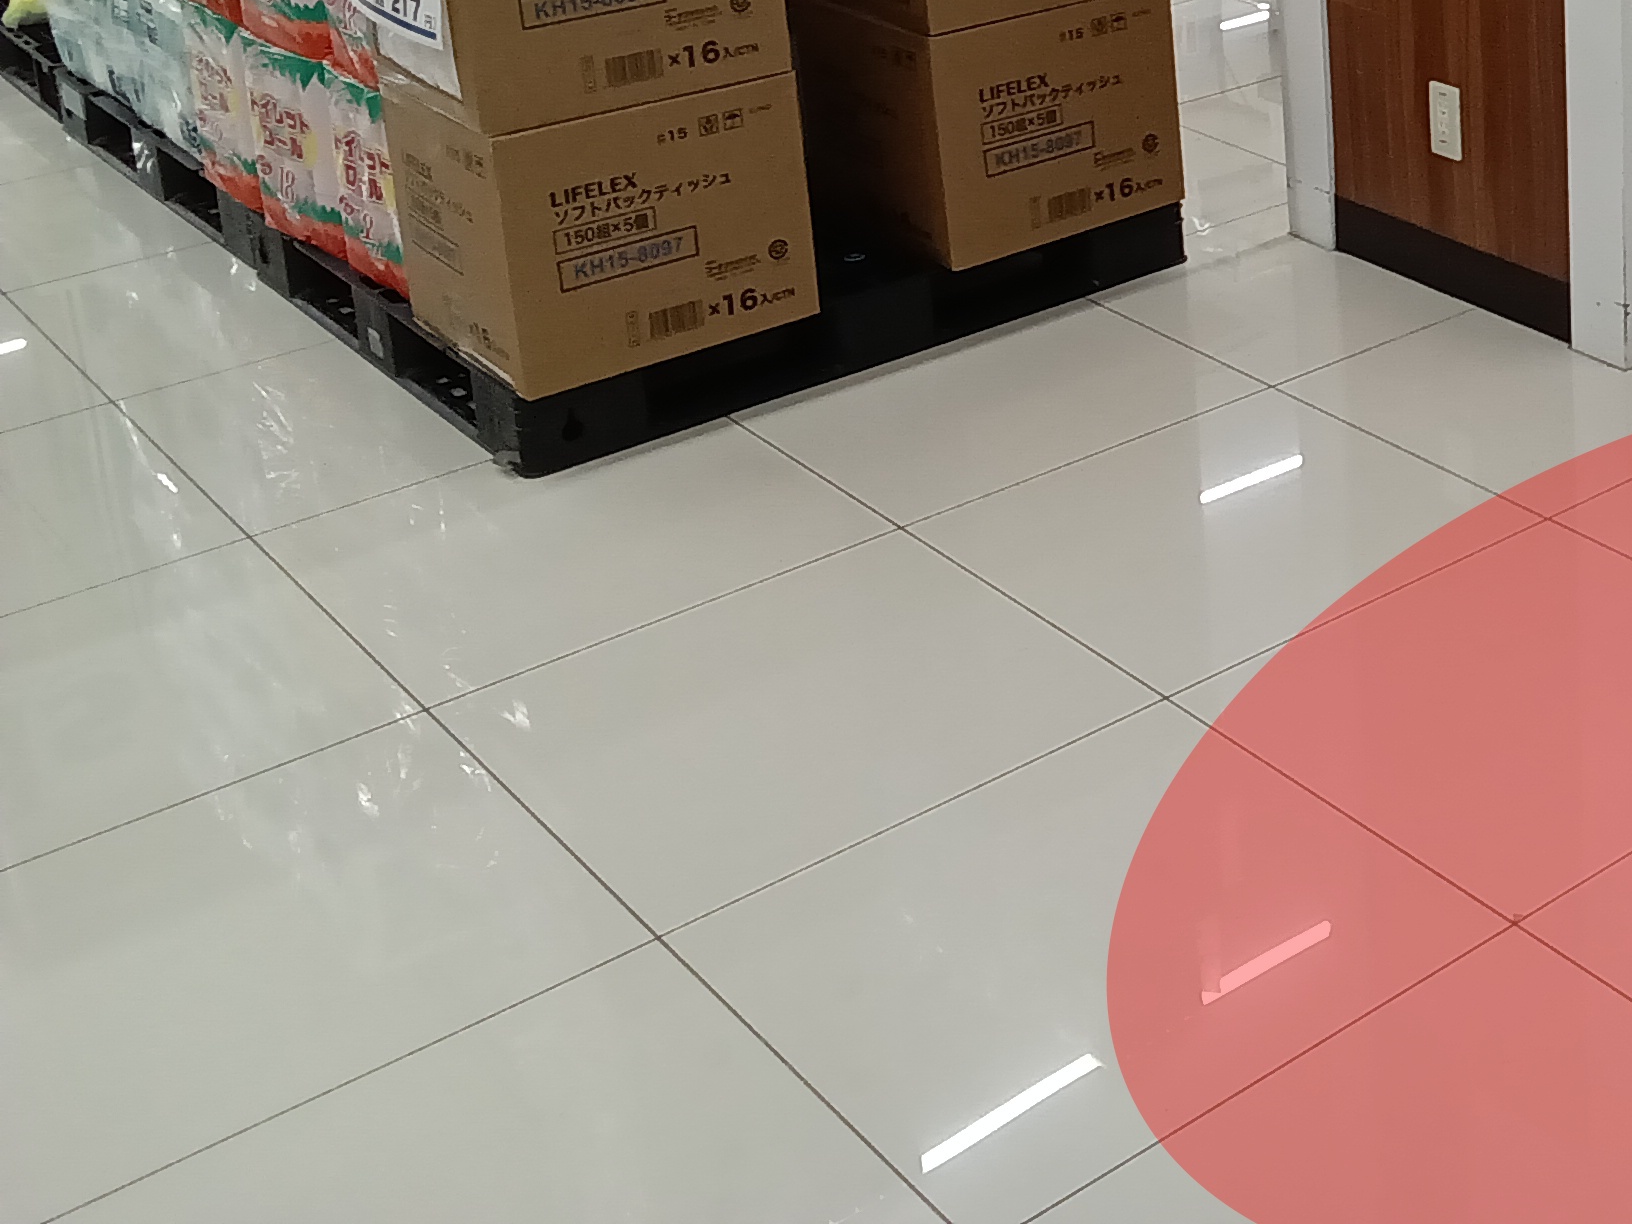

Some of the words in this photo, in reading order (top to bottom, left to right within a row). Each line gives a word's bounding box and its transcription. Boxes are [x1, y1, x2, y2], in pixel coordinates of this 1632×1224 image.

[978, 72, 1051, 103] LIFELEX
[981, 74, 1124, 120] ソフトパックティッシュ
[549, 171, 639, 209] LIFELEX
[554, 172, 732, 226] ソフトパックティッシュ
[574, 236, 684, 280] KH15-8097
